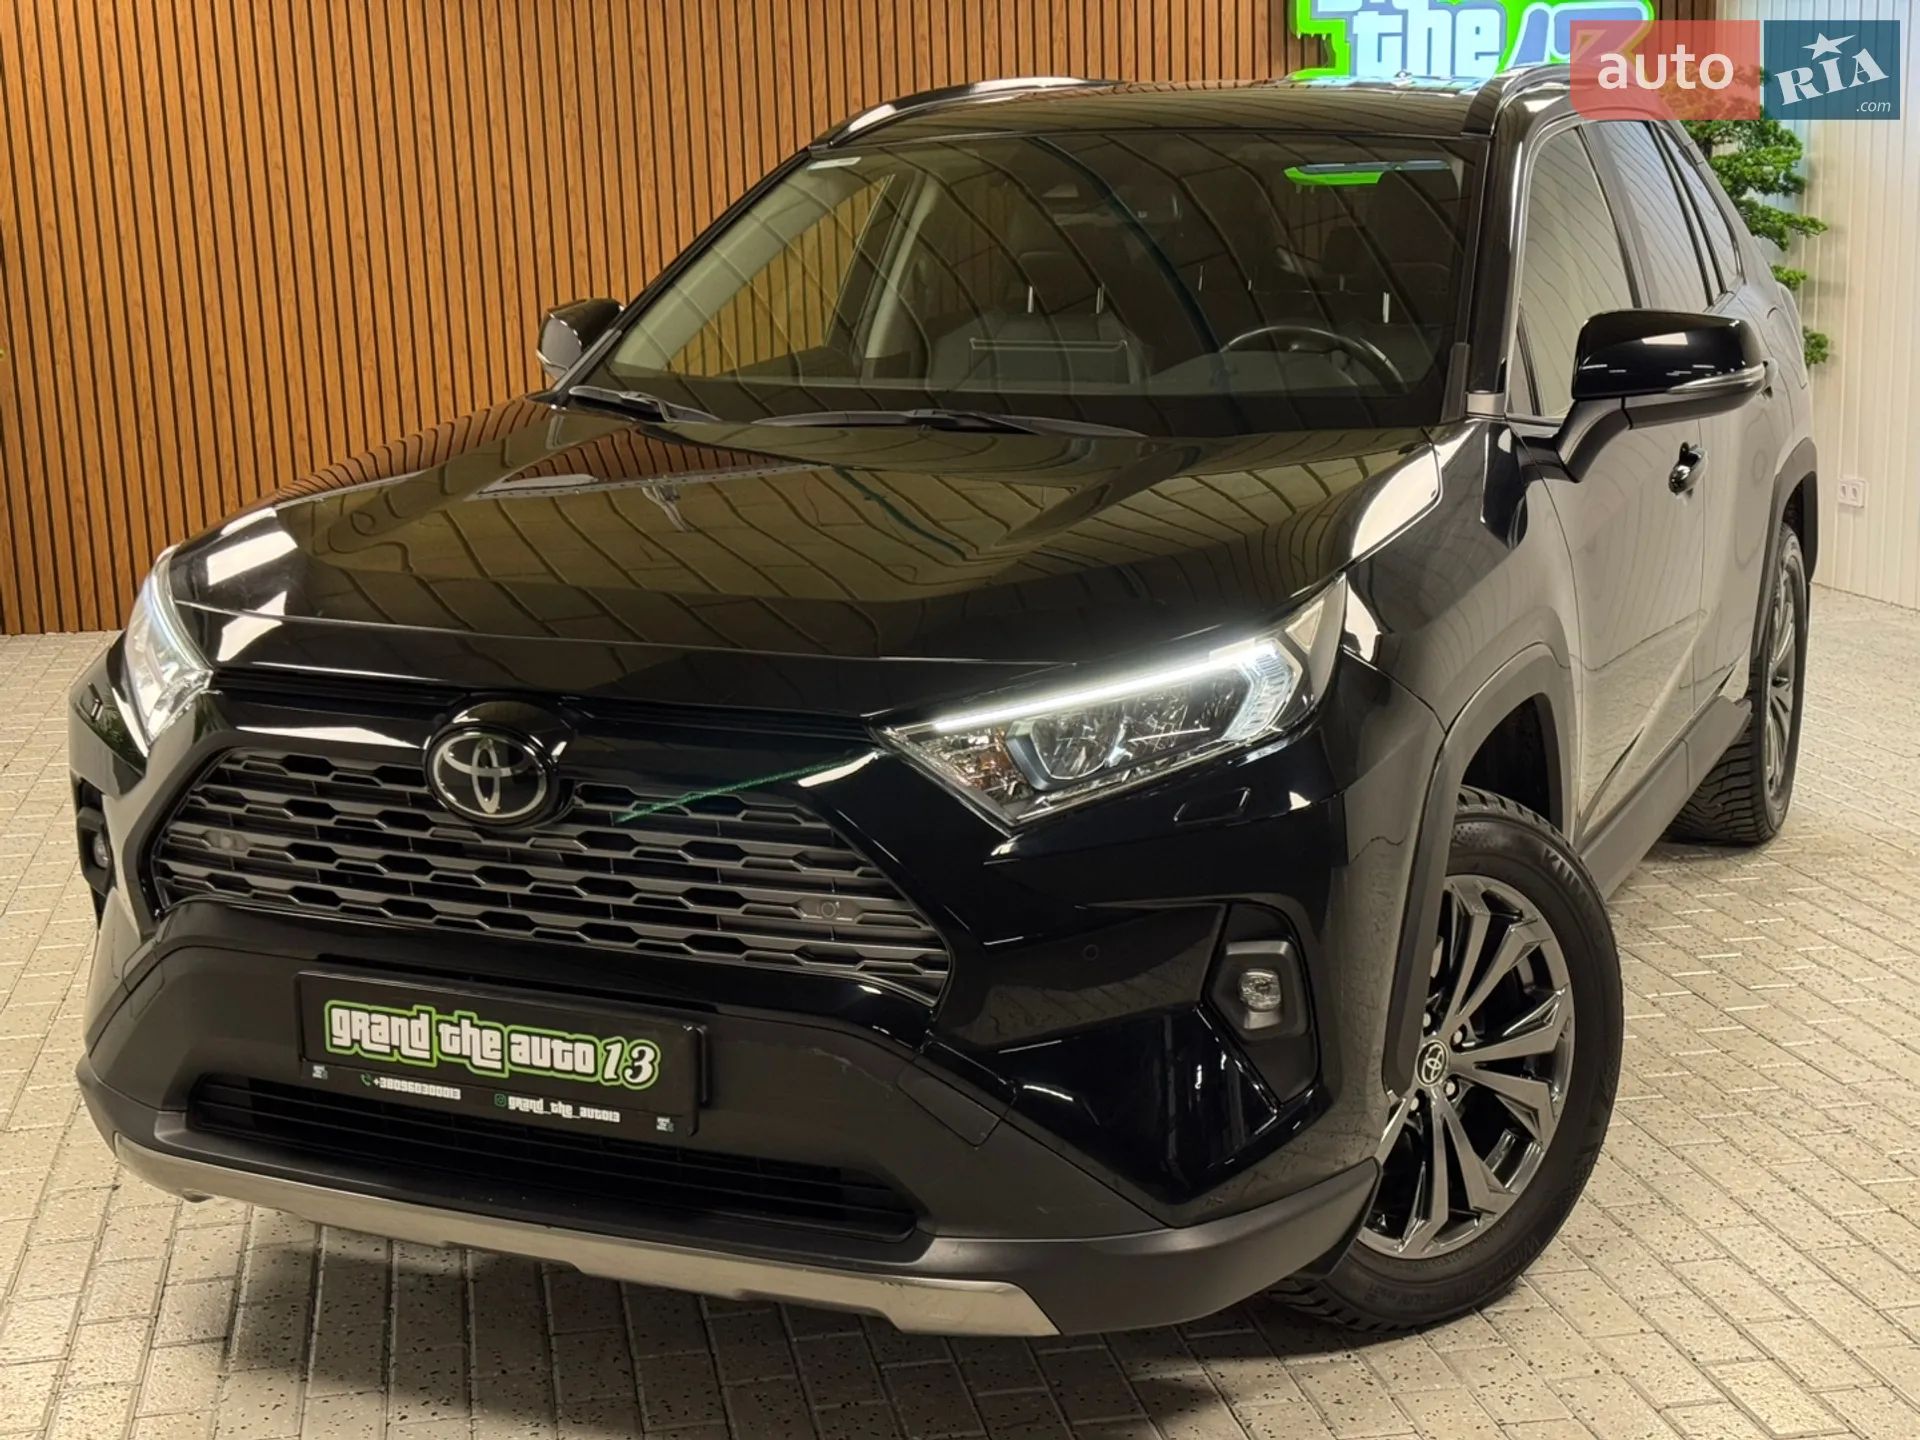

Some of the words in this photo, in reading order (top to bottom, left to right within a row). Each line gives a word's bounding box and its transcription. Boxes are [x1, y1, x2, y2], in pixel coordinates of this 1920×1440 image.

[1352, 0, 1500, 79] the
[331, 1007, 431, 1059] grand
[438, 1018, 503, 1070] the
[510, 1032, 596, 1075] auto
[603, 1042, 656, 1084] 13
